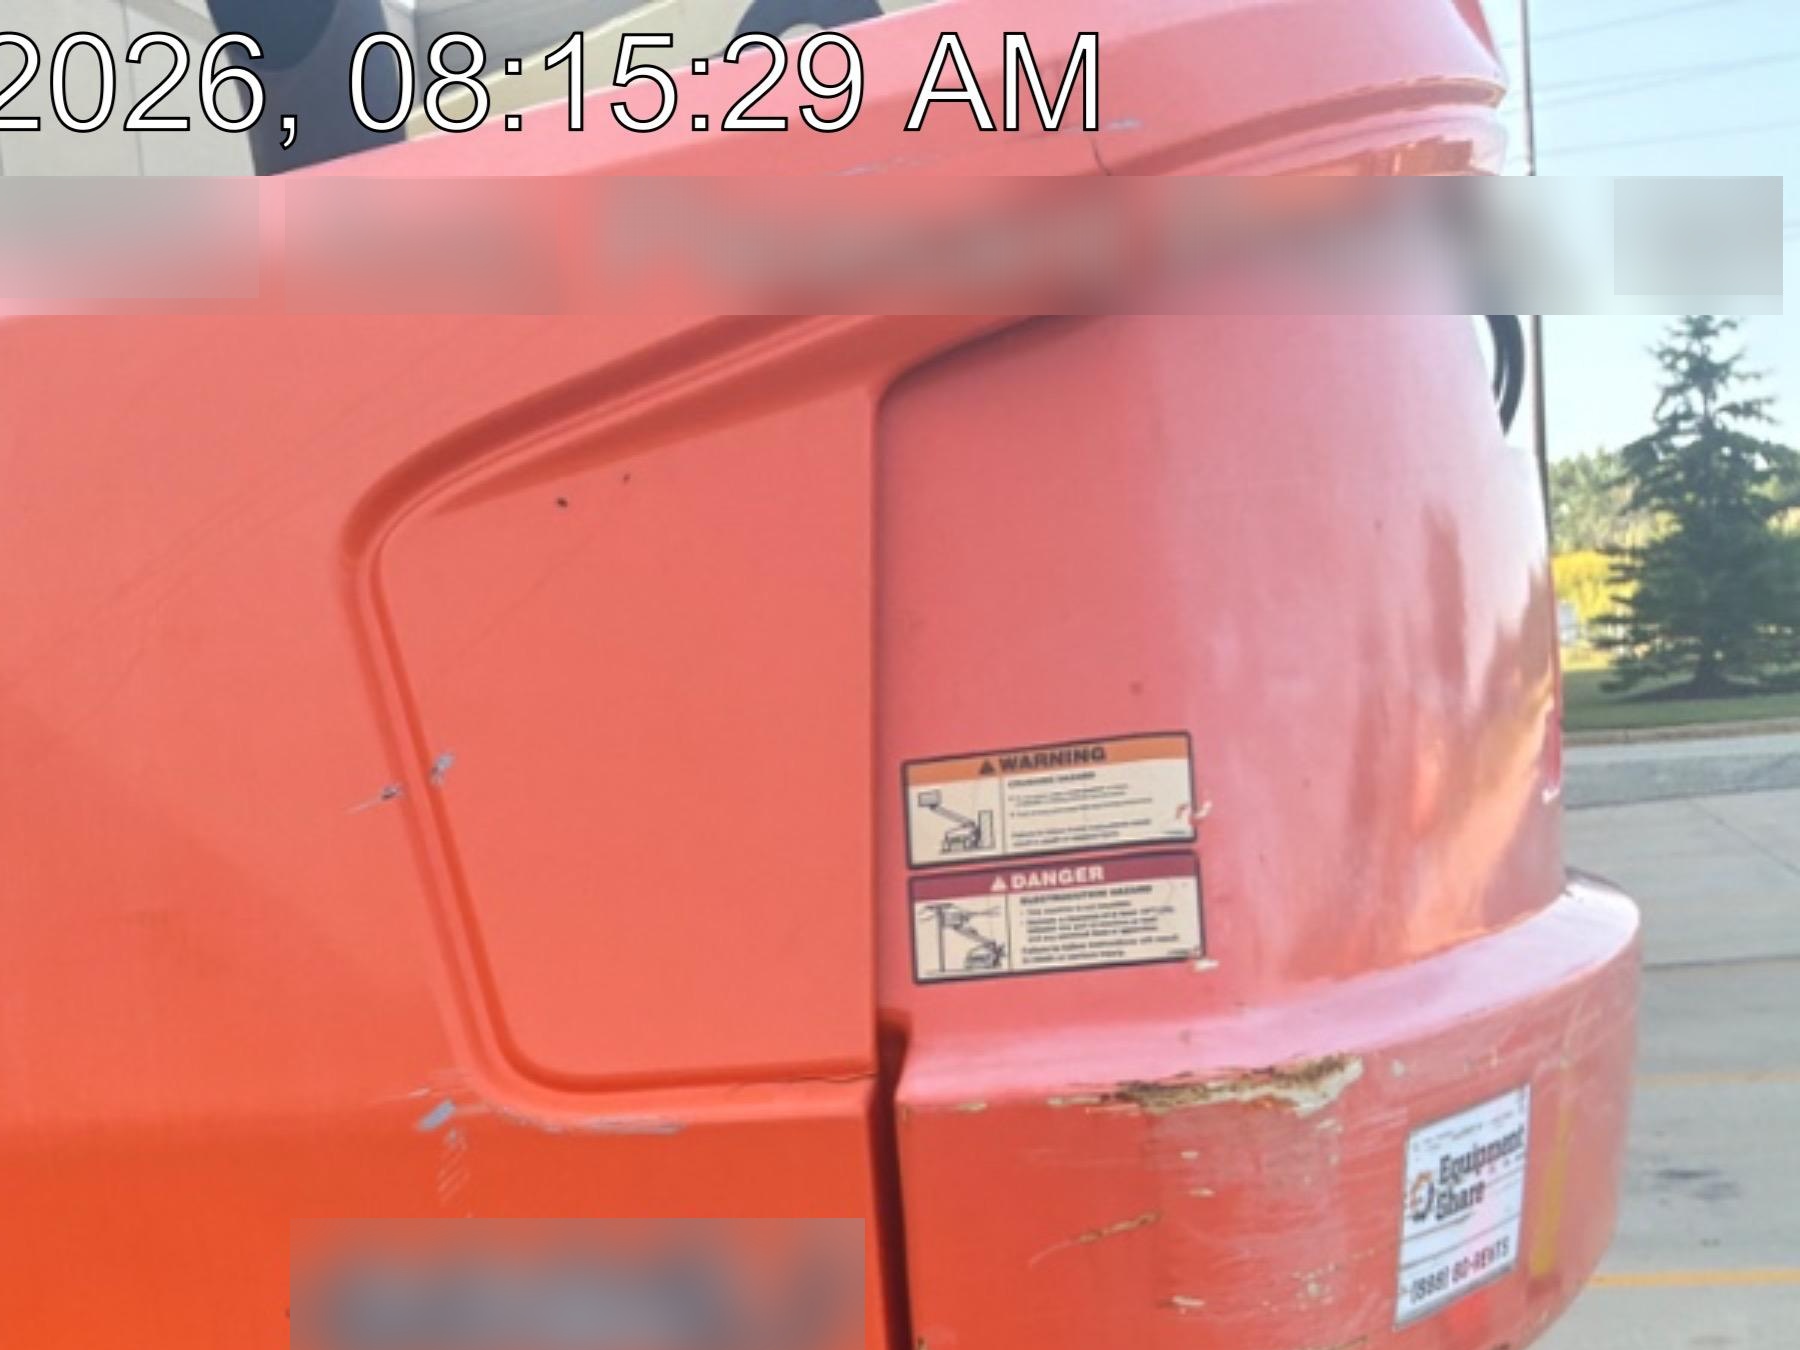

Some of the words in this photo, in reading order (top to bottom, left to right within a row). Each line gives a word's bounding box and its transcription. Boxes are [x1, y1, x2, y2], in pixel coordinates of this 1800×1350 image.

[999, 745, 1107, 772] WARNING
[1011, 865, 1105, 890] DANGER
[1438, 1123, 1525, 1185] Equipment
[1435, 1179, 1487, 1221] Share
